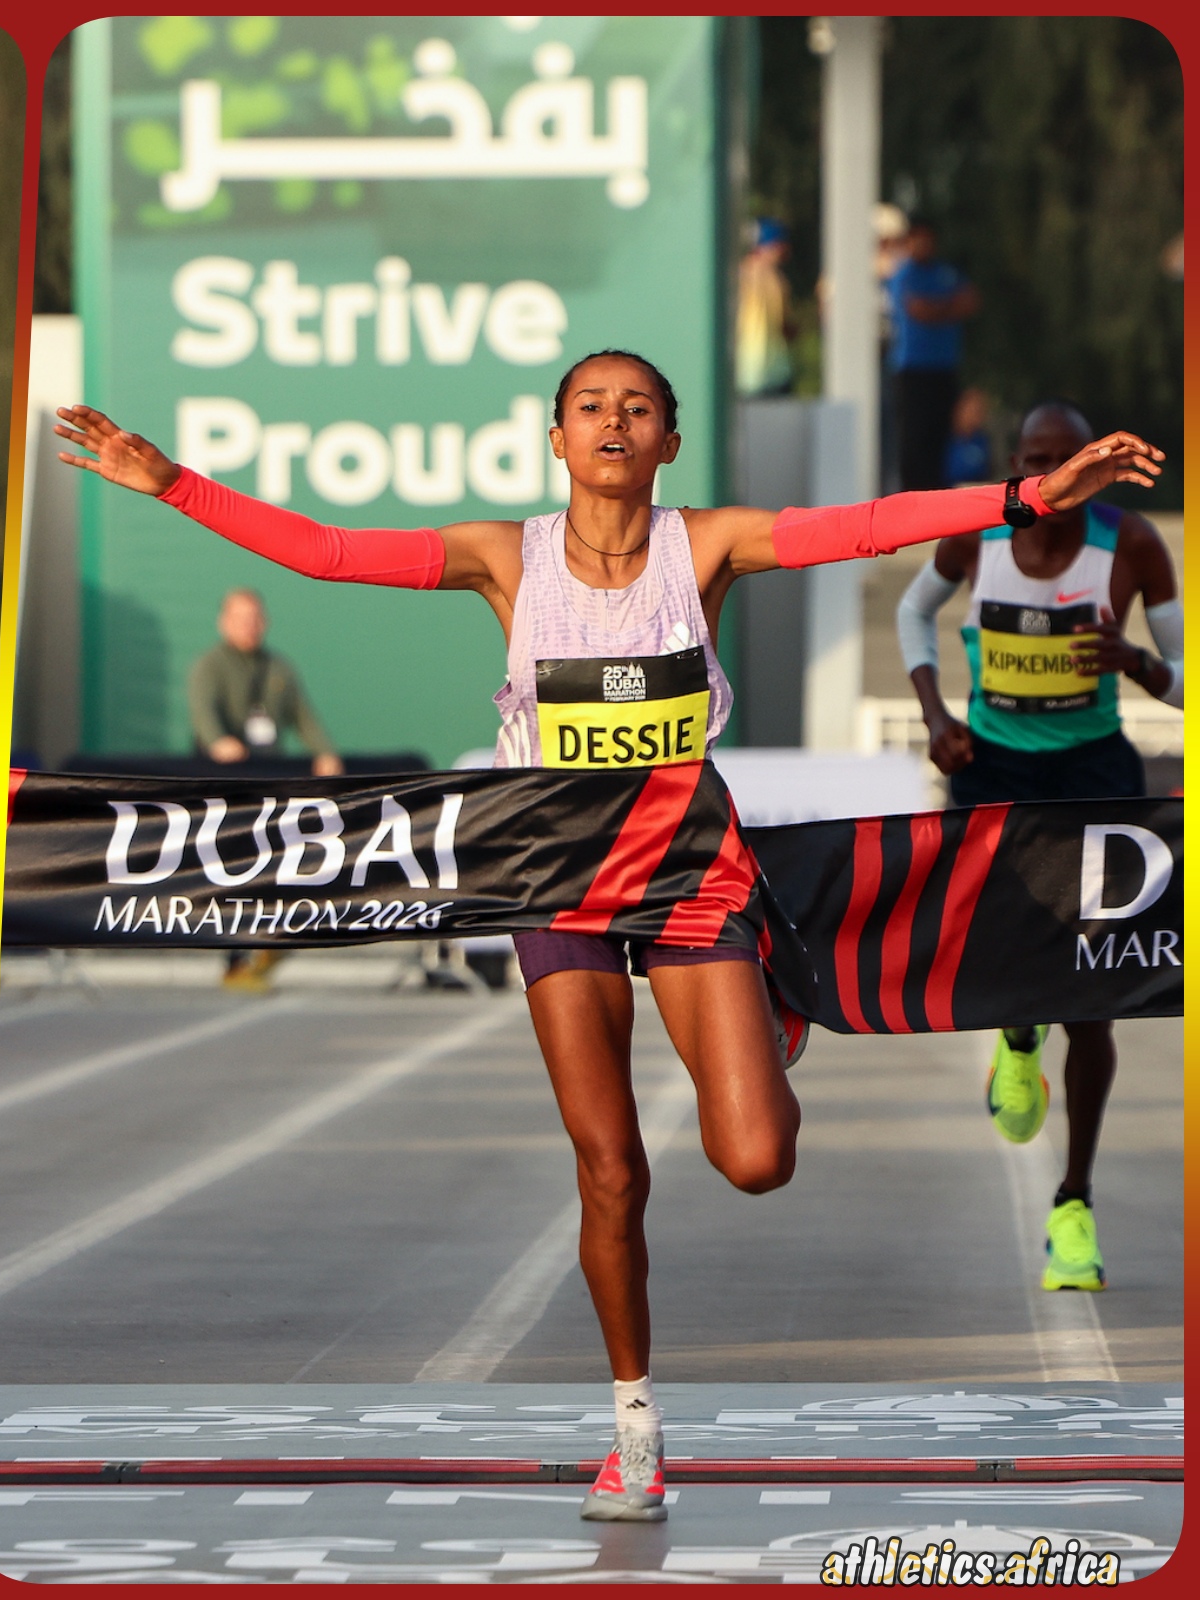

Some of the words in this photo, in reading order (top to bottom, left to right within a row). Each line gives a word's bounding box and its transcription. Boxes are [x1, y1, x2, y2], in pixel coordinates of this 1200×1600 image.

[171, 255, 568, 367] Strive
[177, 396, 660, 505] Proud
[603, 677, 646, 691] DUBAI
[988, 650, 1093, 675] KIPKEMB
[603, 689, 646, 697] MARATHON
[558, 716, 694, 763] DESSIE
[105, 793, 464, 890] DUBAI
[94, 895, 352, 936] MARATHON
[349, 900, 454, 931] 2026
[1075, 929, 1182, 972] MAR
